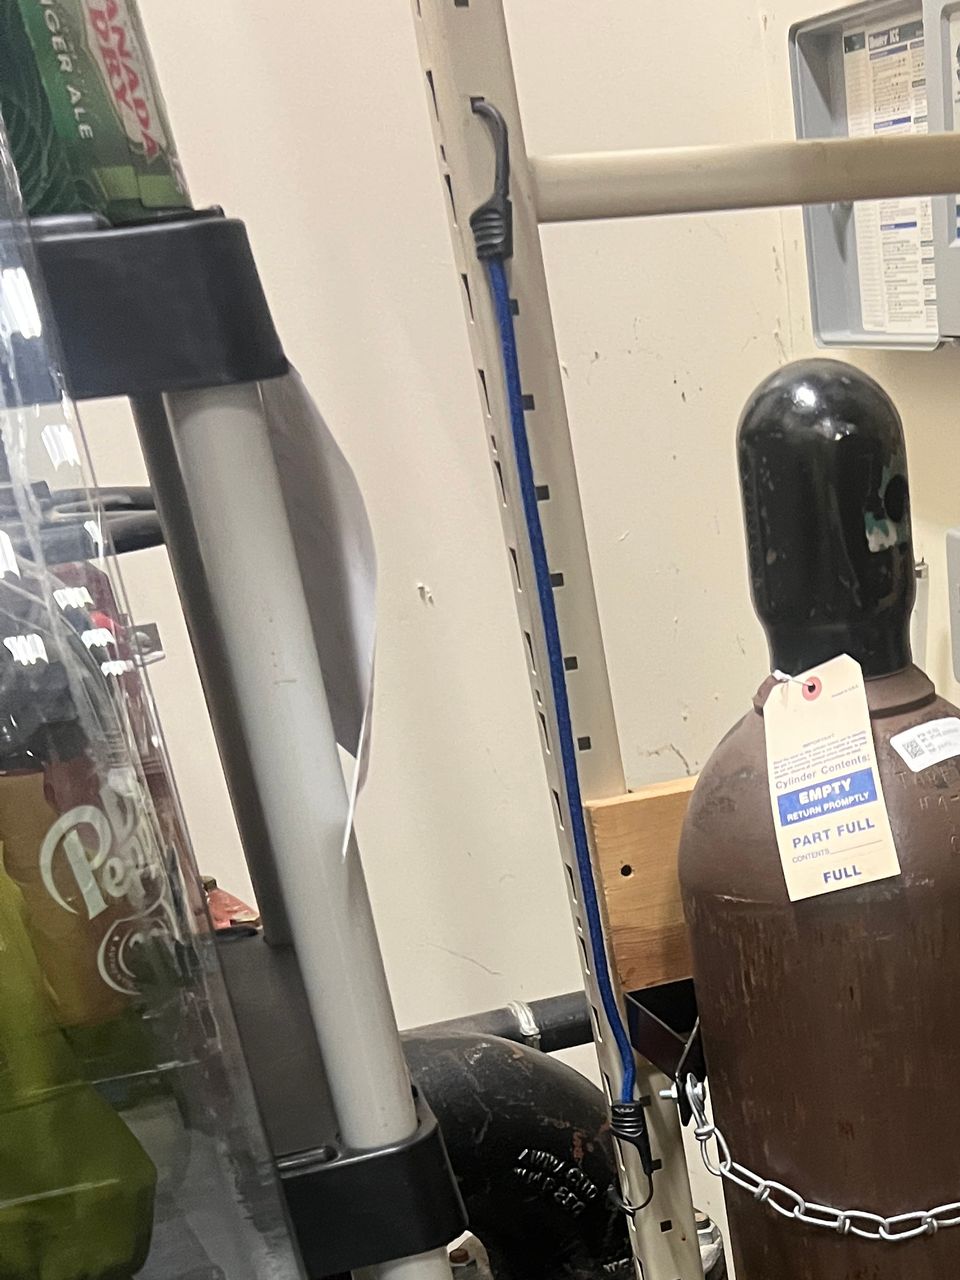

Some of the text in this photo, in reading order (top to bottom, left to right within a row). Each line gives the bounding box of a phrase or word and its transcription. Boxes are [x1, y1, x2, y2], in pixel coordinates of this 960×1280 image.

[40, 0, 94, 140] GER ALE
[88, 4, 134, 109] DRY
[103, 0, 159, 158] ANADA
[775, 770, 816, 790] Cylinder
[821, 754, 871, 775] Contents:
[787, 791, 869, 821] RETURN PROMPTLY
[798, 777, 852, 805] EMPTY
[792, 817, 876, 848] PART FULL
[792, 848, 830, 864] CONTENTS
[823, 864, 862, 883] FULL
